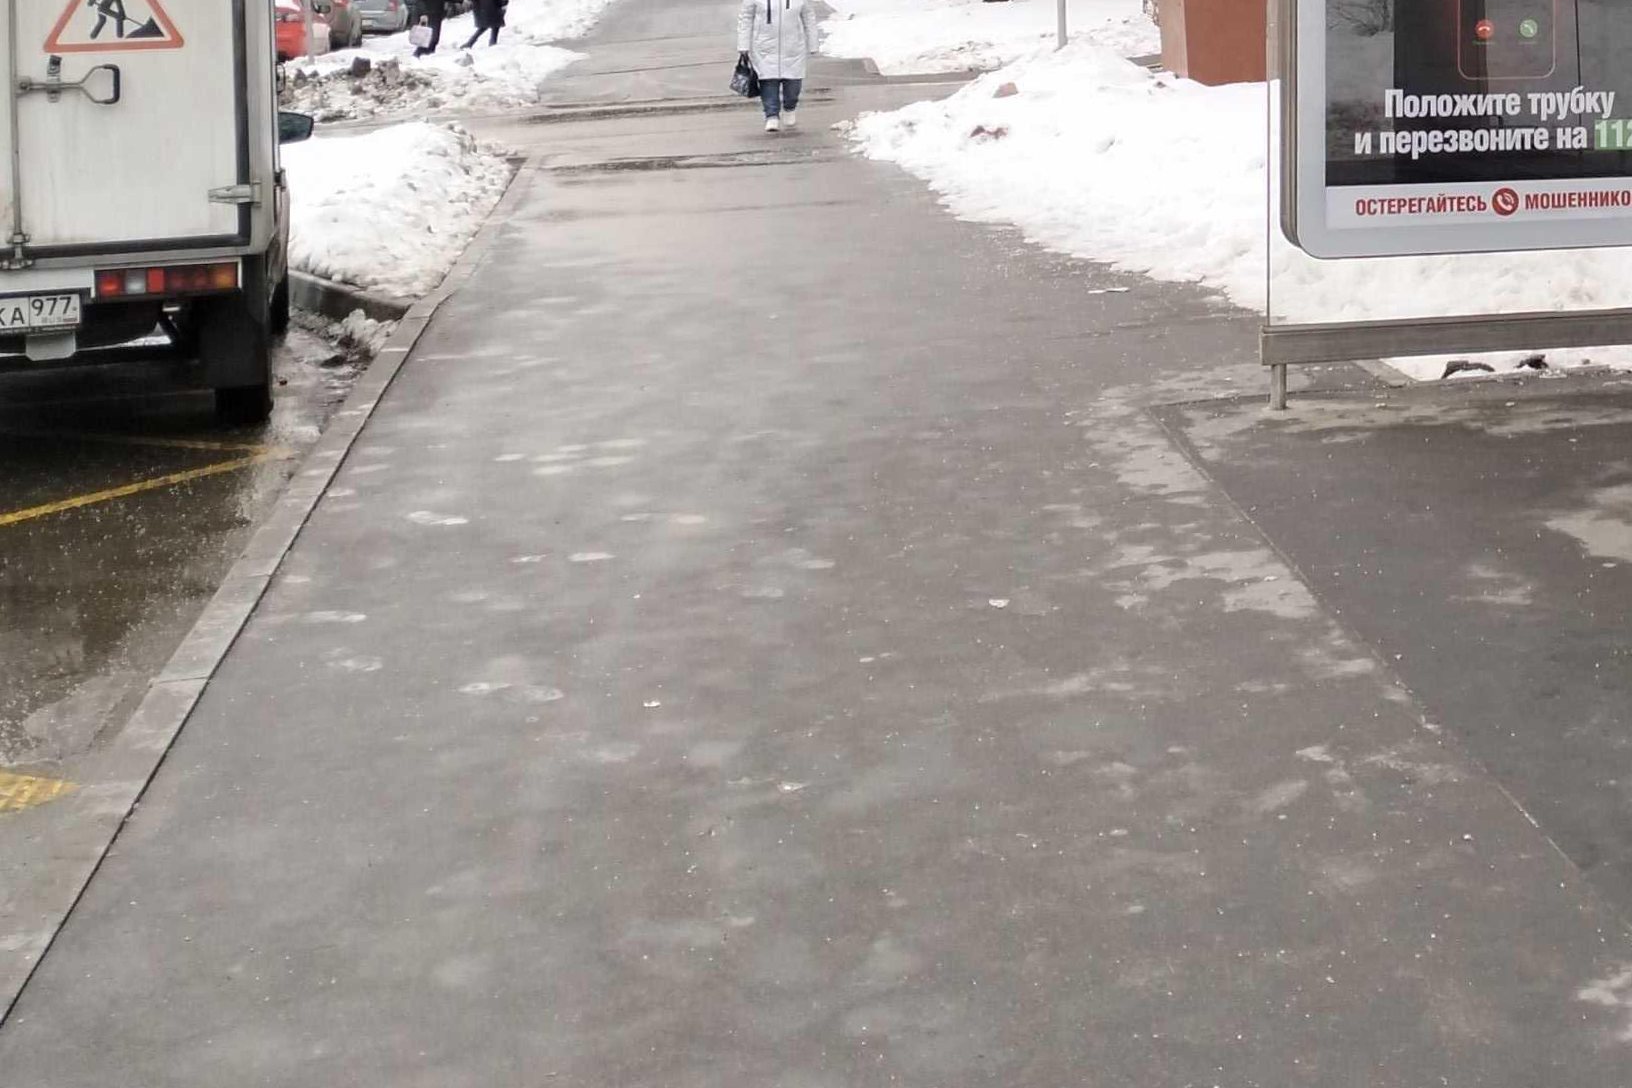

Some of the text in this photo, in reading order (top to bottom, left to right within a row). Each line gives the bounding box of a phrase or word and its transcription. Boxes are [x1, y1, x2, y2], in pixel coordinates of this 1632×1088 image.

[1384, 85, 1616, 121] Положите трубку
[1354, 131, 1372, 155] и
[1379, 127, 1549, 160] перезвоните
[1556, 125, 1588, 150] на
[1355, 193, 1488, 216] ОСТЕРЕГАЙТЕСЬ
[31, 296, 72, 317] 977
